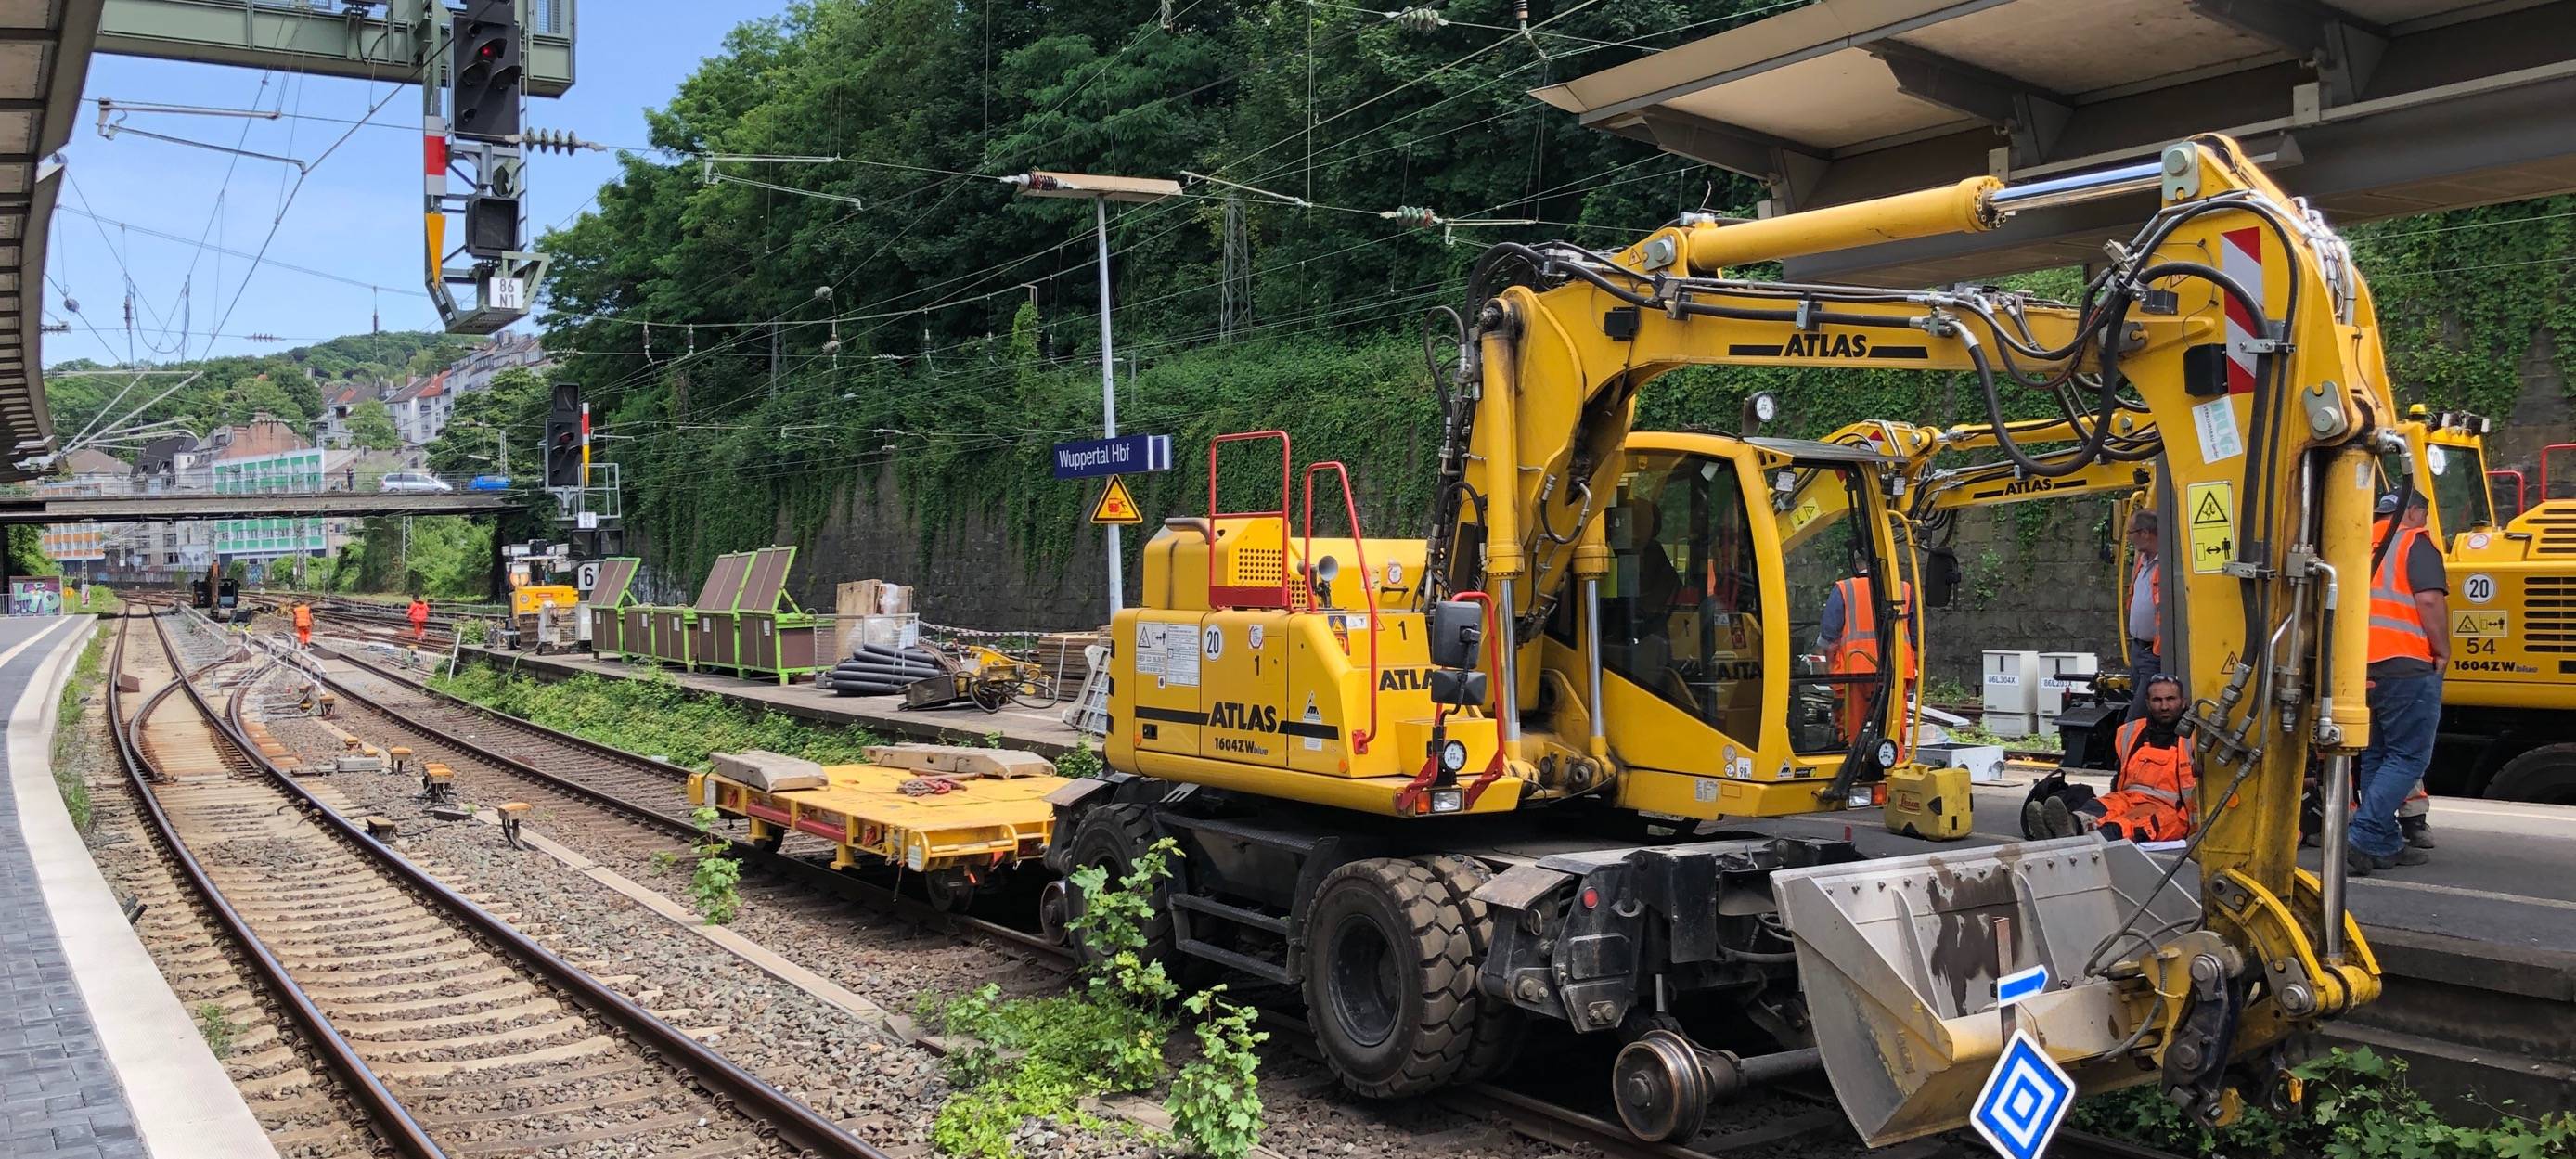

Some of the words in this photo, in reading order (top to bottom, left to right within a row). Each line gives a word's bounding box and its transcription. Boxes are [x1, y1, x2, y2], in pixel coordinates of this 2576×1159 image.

[499, 278, 515, 293] 86
[499, 294, 515, 308] N1
[1784, 333, 1867, 358] ATLAS
[1059, 446, 1110, 470] Wuppertal
[1112, 443, 1130, 463] Hbf
[2004, 478, 2052, 496] ATLAS
[584, 567, 594, 586] 6
[2469, 578, 2490, 599] 20
[1397, 620, 1408, 641] 1
[1206, 630, 1219, 654] 20
[2466, 638, 2497, 655] 54
[1254, 654, 1260, 676] 1
[1379, 668, 1434, 691] ATLA
[1988, 675, 2016, 685] 86L304X
[1209, 701, 1277, 734] ATLAS
